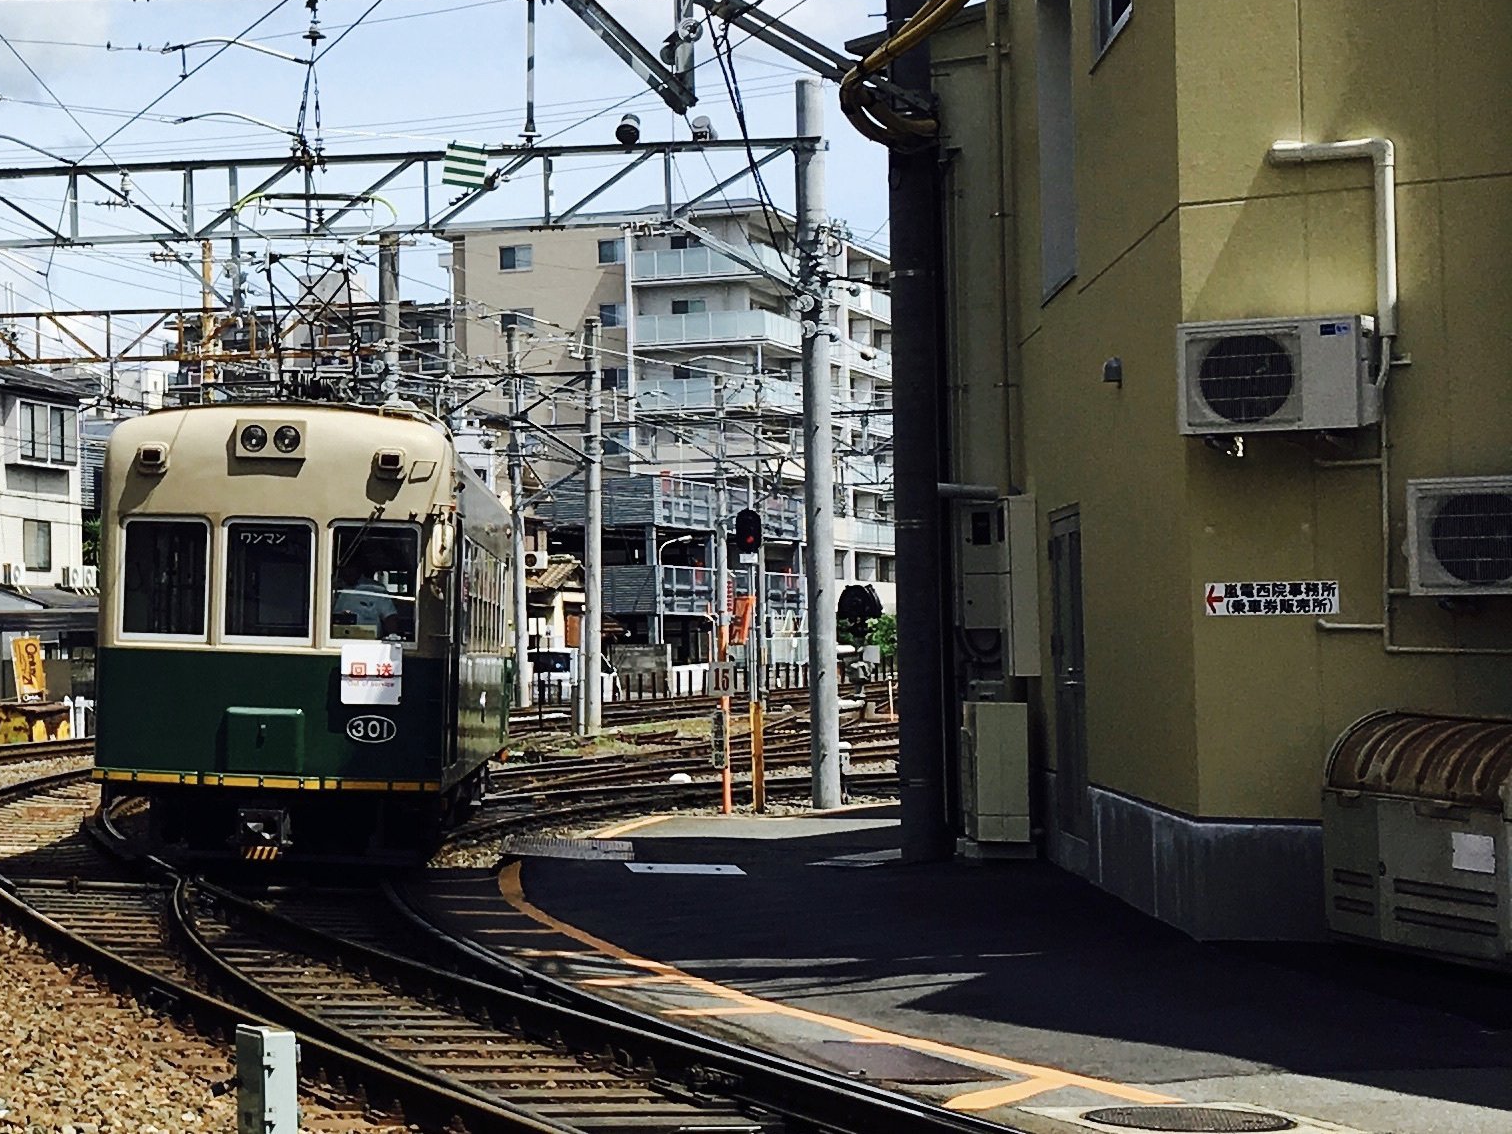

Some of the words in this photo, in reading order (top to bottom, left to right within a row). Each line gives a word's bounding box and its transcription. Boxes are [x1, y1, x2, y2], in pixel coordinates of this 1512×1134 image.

[240, 532, 286, 544] ワンマン
[1224, 582, 1336, 598] 嵐電西院事務所
[351, 662, 393, 677] 回送
[713, 667, 730, 691] 15
[352, 720, 388, 738] 301
